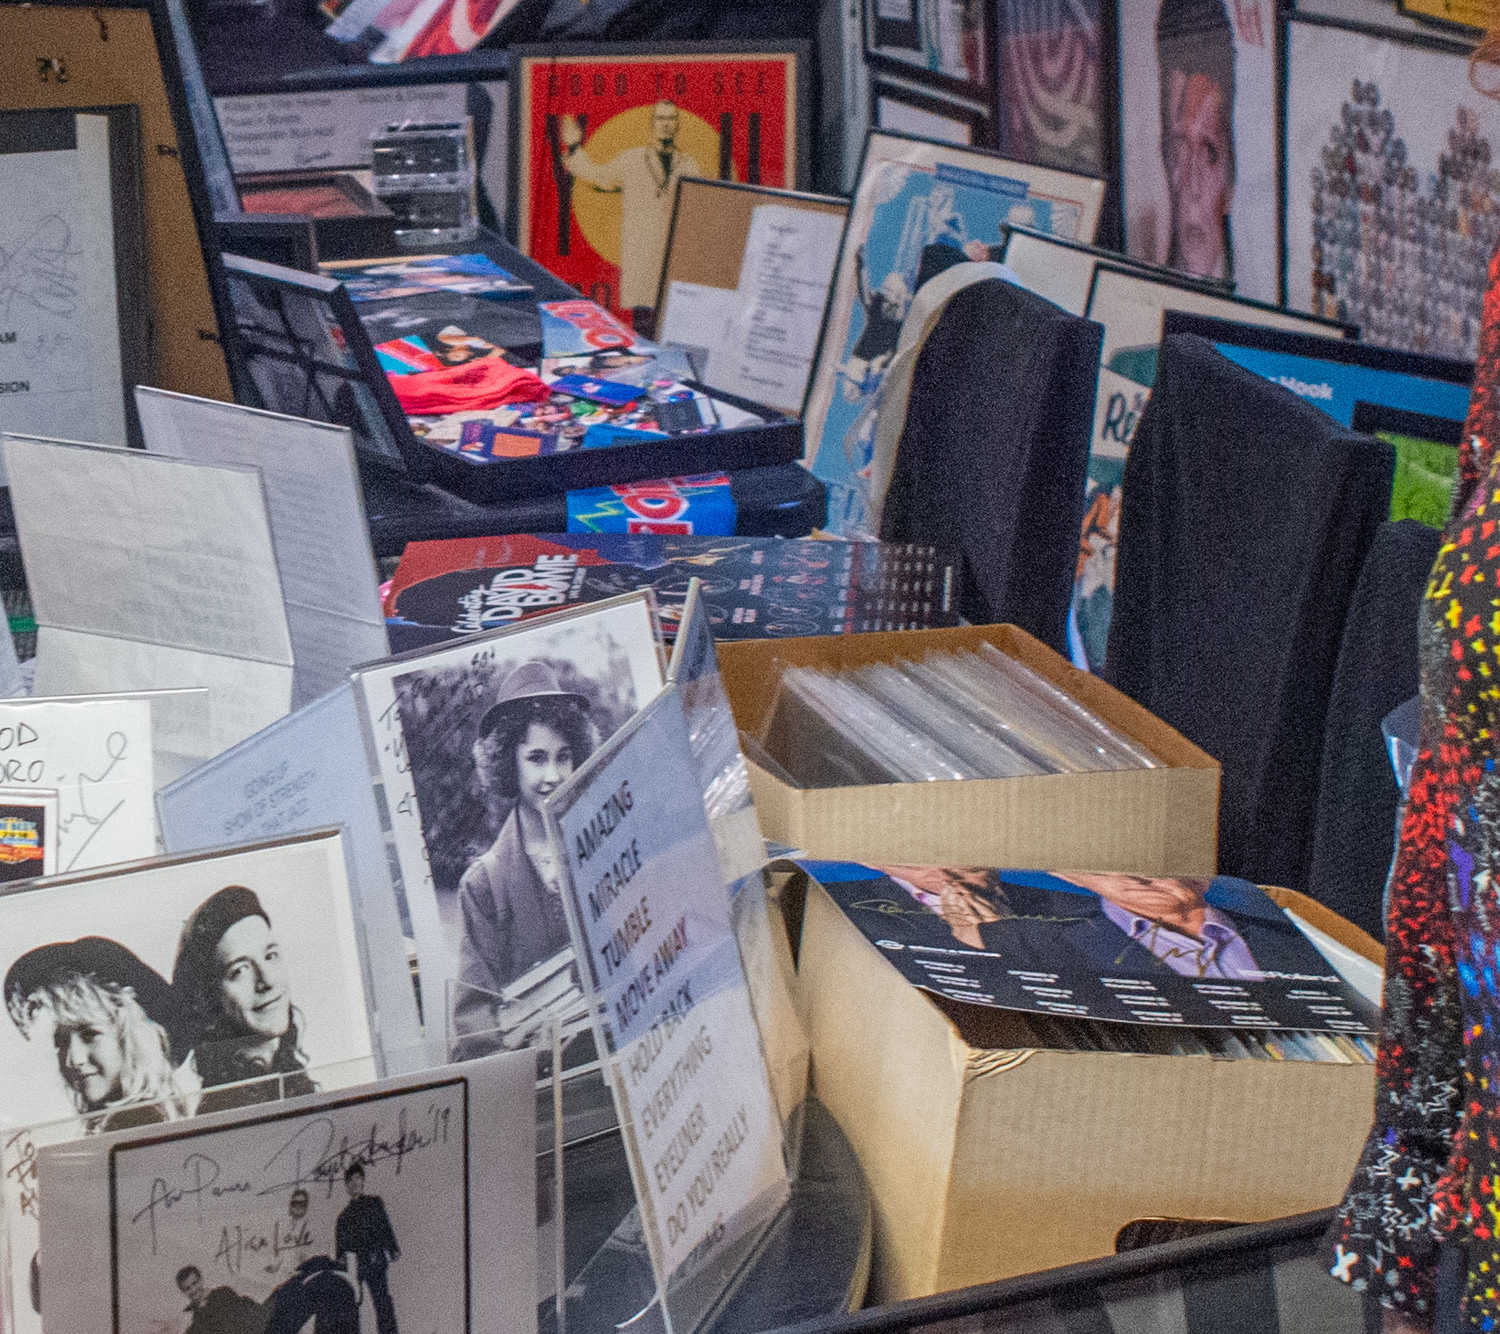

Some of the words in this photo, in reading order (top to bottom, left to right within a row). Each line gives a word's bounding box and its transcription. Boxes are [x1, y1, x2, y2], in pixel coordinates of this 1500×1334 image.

[482, 568, 536, 627] DAVID
[525, 554, 579, 607] BOWIE
[576, 780, 635, 865] AMAZING
[588, 838, 643, 923] MIRACLE
[601, 895, 652, 977] TUMBLE
[616, 964, 653, 1032] MOVE
[652, 916, 688, 987] AWAY
[628, 1023, 665, 1086] HOLD
[662, 979, 694, 1037] BACK
[640, 1024, 713, 1139] EVERYTHING
[653, 1102, 708, 1194] EYELINER
[667, 1205, 687, 1249] DO
[685, 1165, 712, 1217] YOU
[710, 1106, 751, 1185] REALLY
